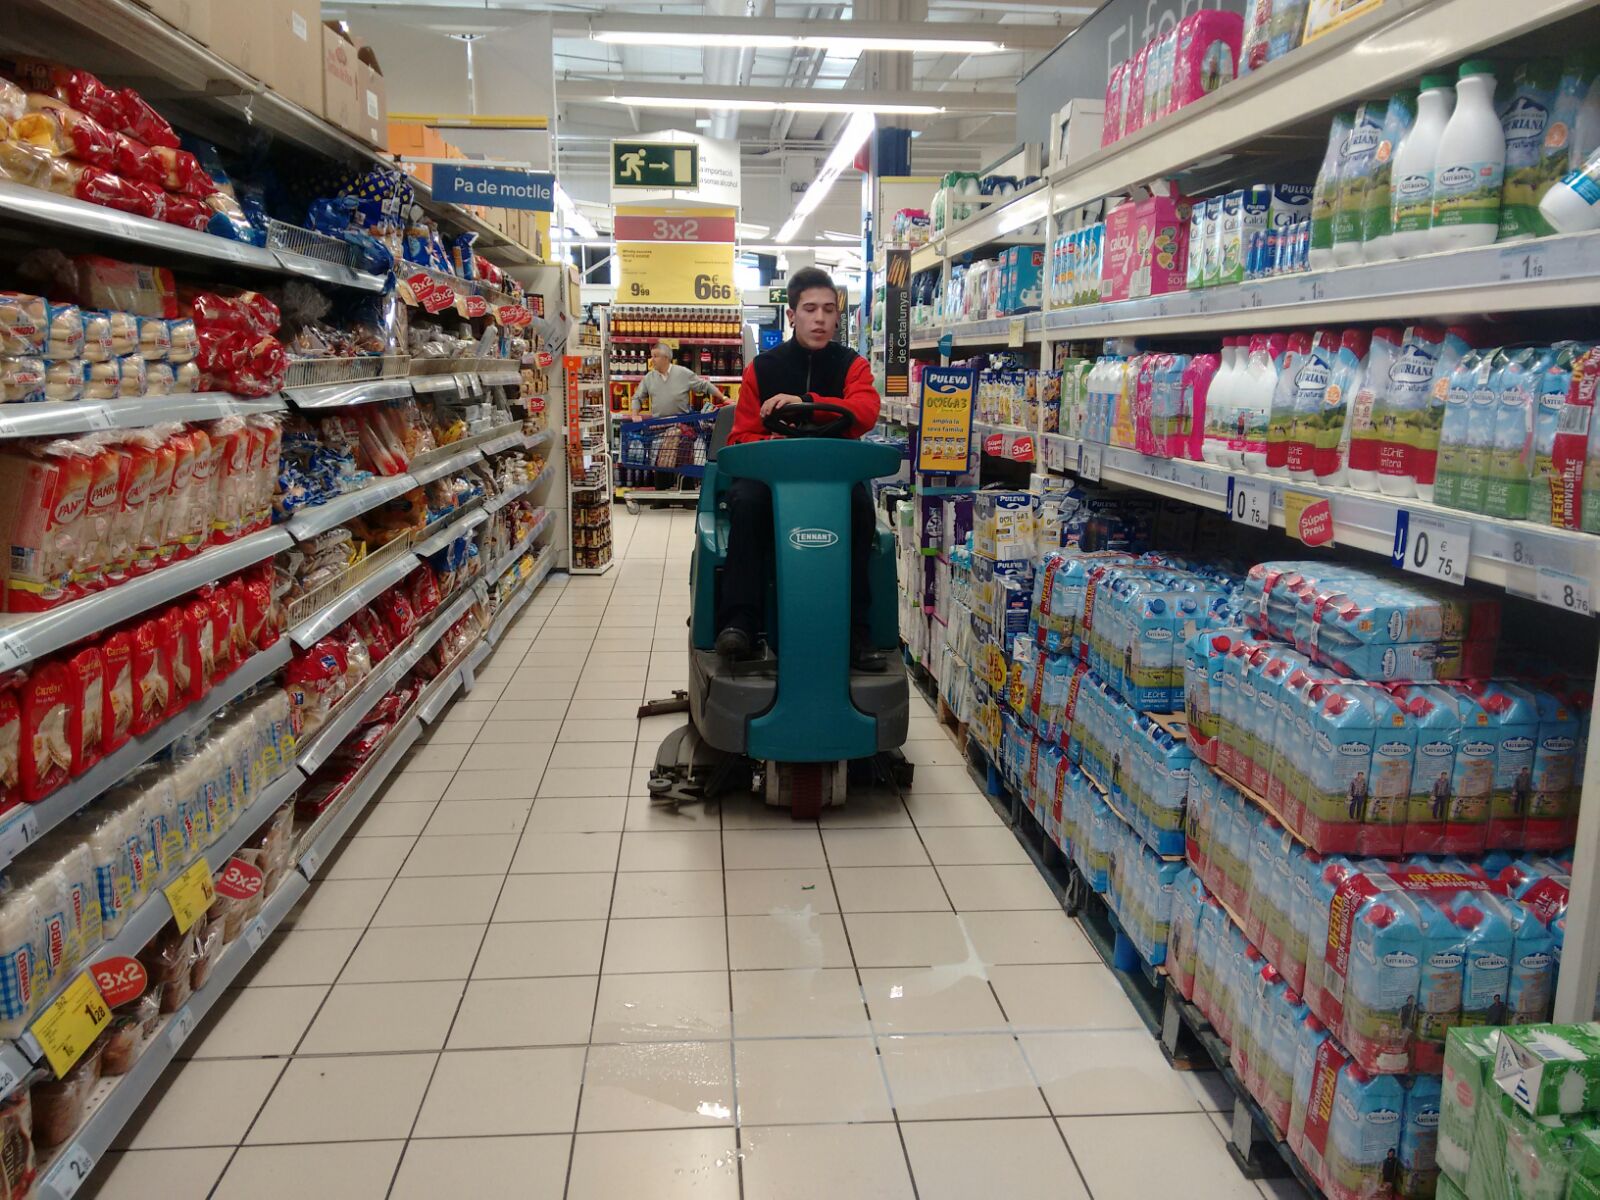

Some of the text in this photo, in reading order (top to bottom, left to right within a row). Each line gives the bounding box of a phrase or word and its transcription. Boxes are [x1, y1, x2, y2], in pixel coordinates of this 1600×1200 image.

[454, 177, 551, 200] Pa de motlle
[653, 219, 698, 240] 3x2
[411, 276, 434, 293] 3x2
[468, 301, 486, 309] 3x2
[500, 308, 518, 318] 3x2
[840, 313, 848, 347] atalunya
[897, 292, 909, 364] de Catalunya
[929, 373, 968, 384] PULEVA
[927, 397, 960, 408] OMEGA
[1013, 443, 1031, 455] 3x2
[1237, 491, 1246, 519] 0
[1251, 509, 1260, 523] 75
[1301, 511, 1330, 528] Súper
[796, 533, 832, 543] TENNANT
[1303, 524, 1326, 538] Preu
[1413, 532, 1429, 568] 0
[1437, 556, 1453, 576] 75
[1563, 584, 1588, 612] 8.76
[225, 867, 261, 892] 3x2
[1407, 873, 1466, 883] OFERTA
[1329, 895, 1344, 947] OFERTA
[18, 952, 30, 1003] BIMBO
[97, 963, 142, 990] 3x2
